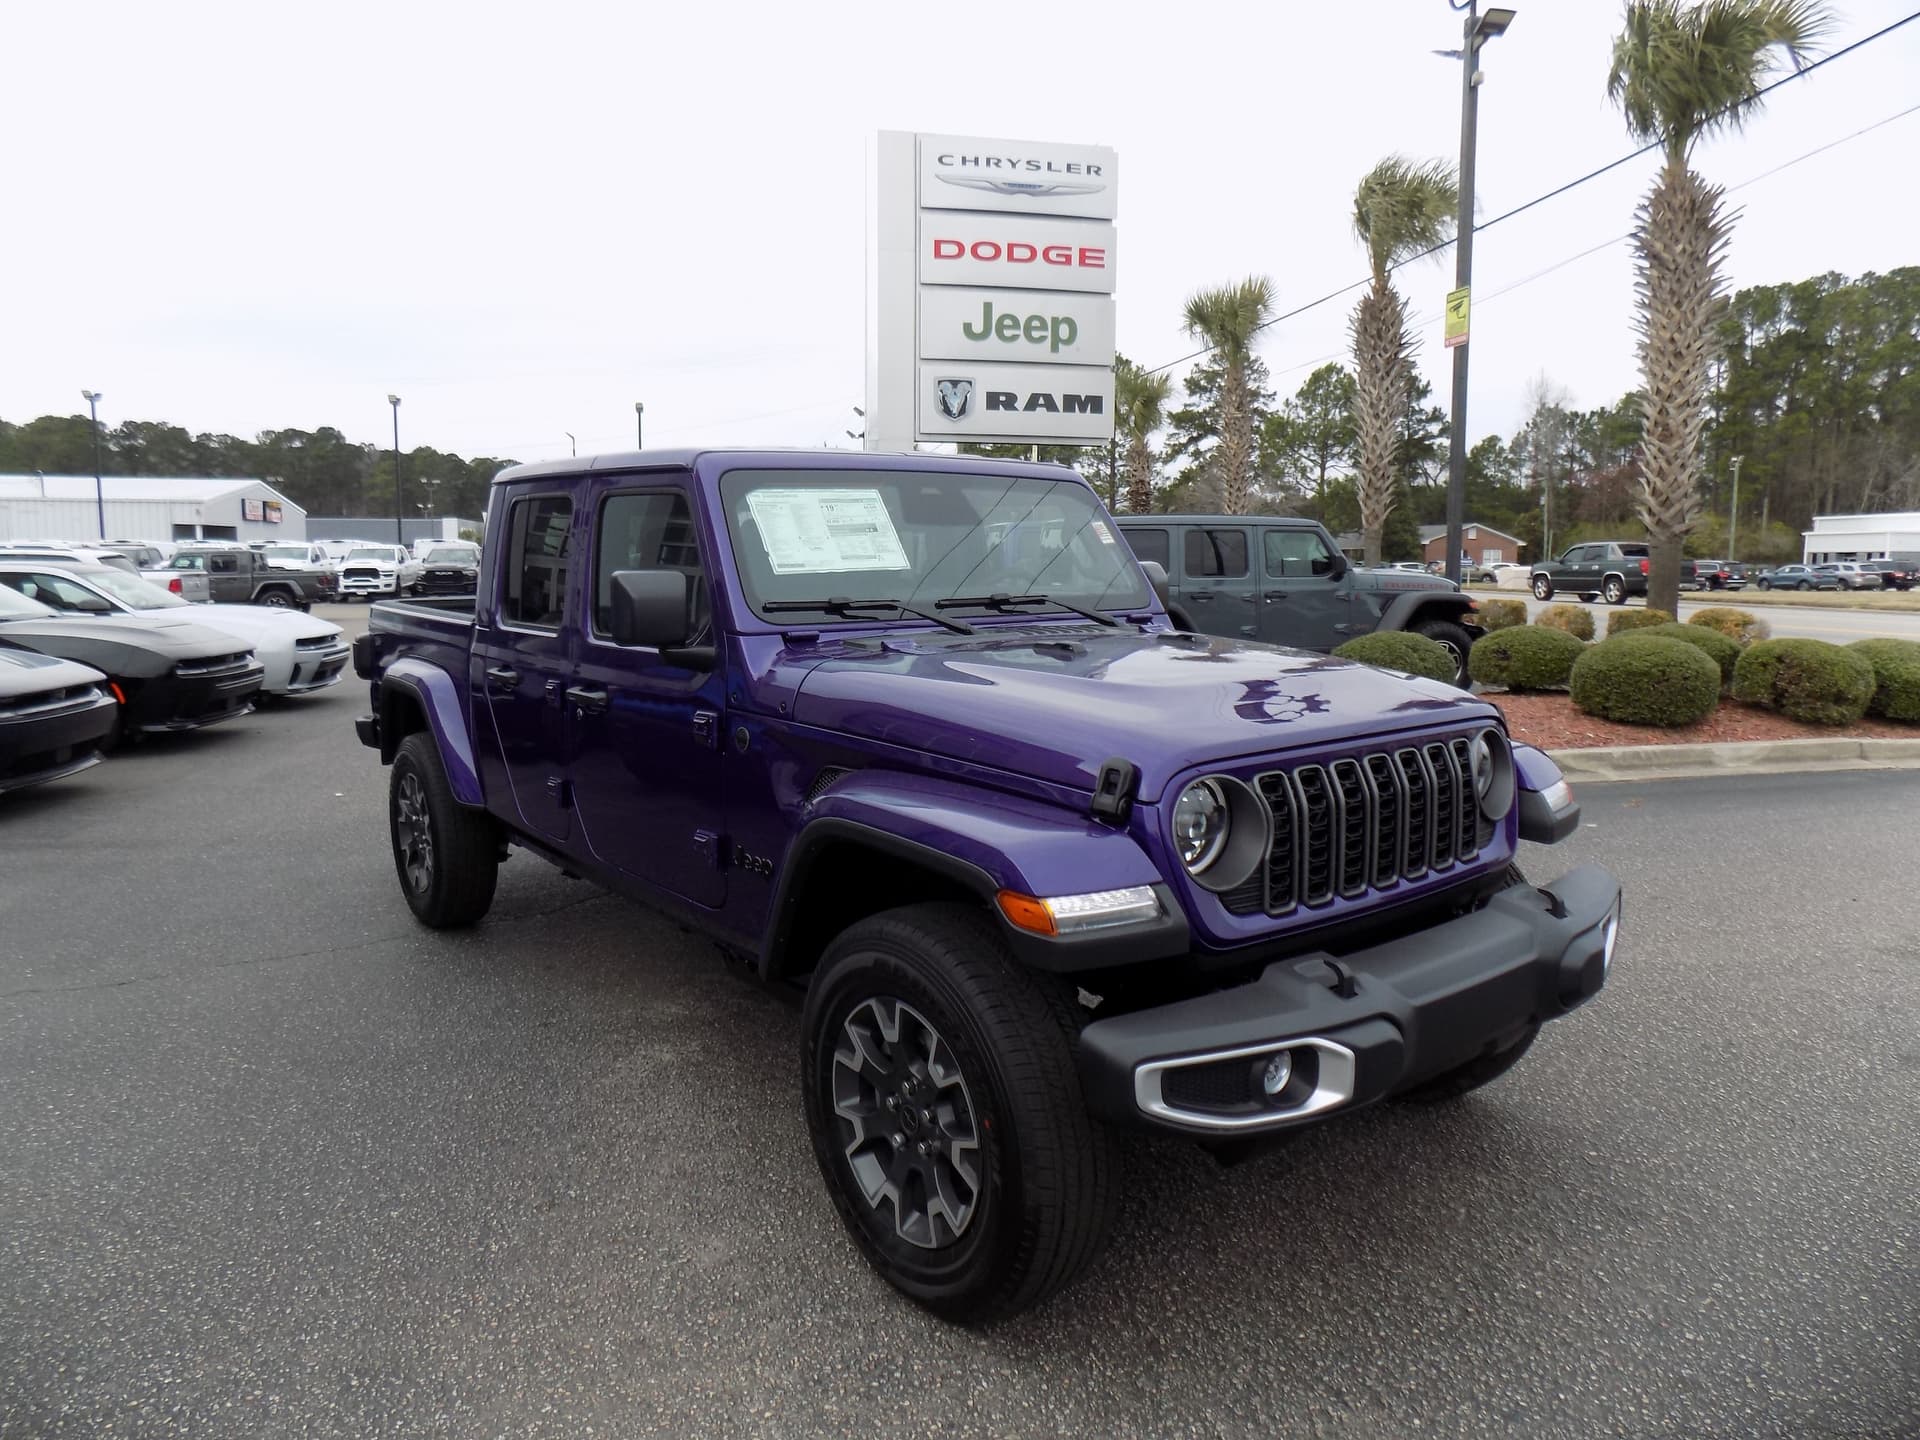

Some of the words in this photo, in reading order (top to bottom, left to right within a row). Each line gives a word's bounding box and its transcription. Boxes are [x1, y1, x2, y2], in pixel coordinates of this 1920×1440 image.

[937, 154, 1103, 177] CHRYSLER
[933, 239, 1106, 269] DODGE
[962, 301, 1079, 353] Jeep
[985, 391, 1104, 415] RAM
